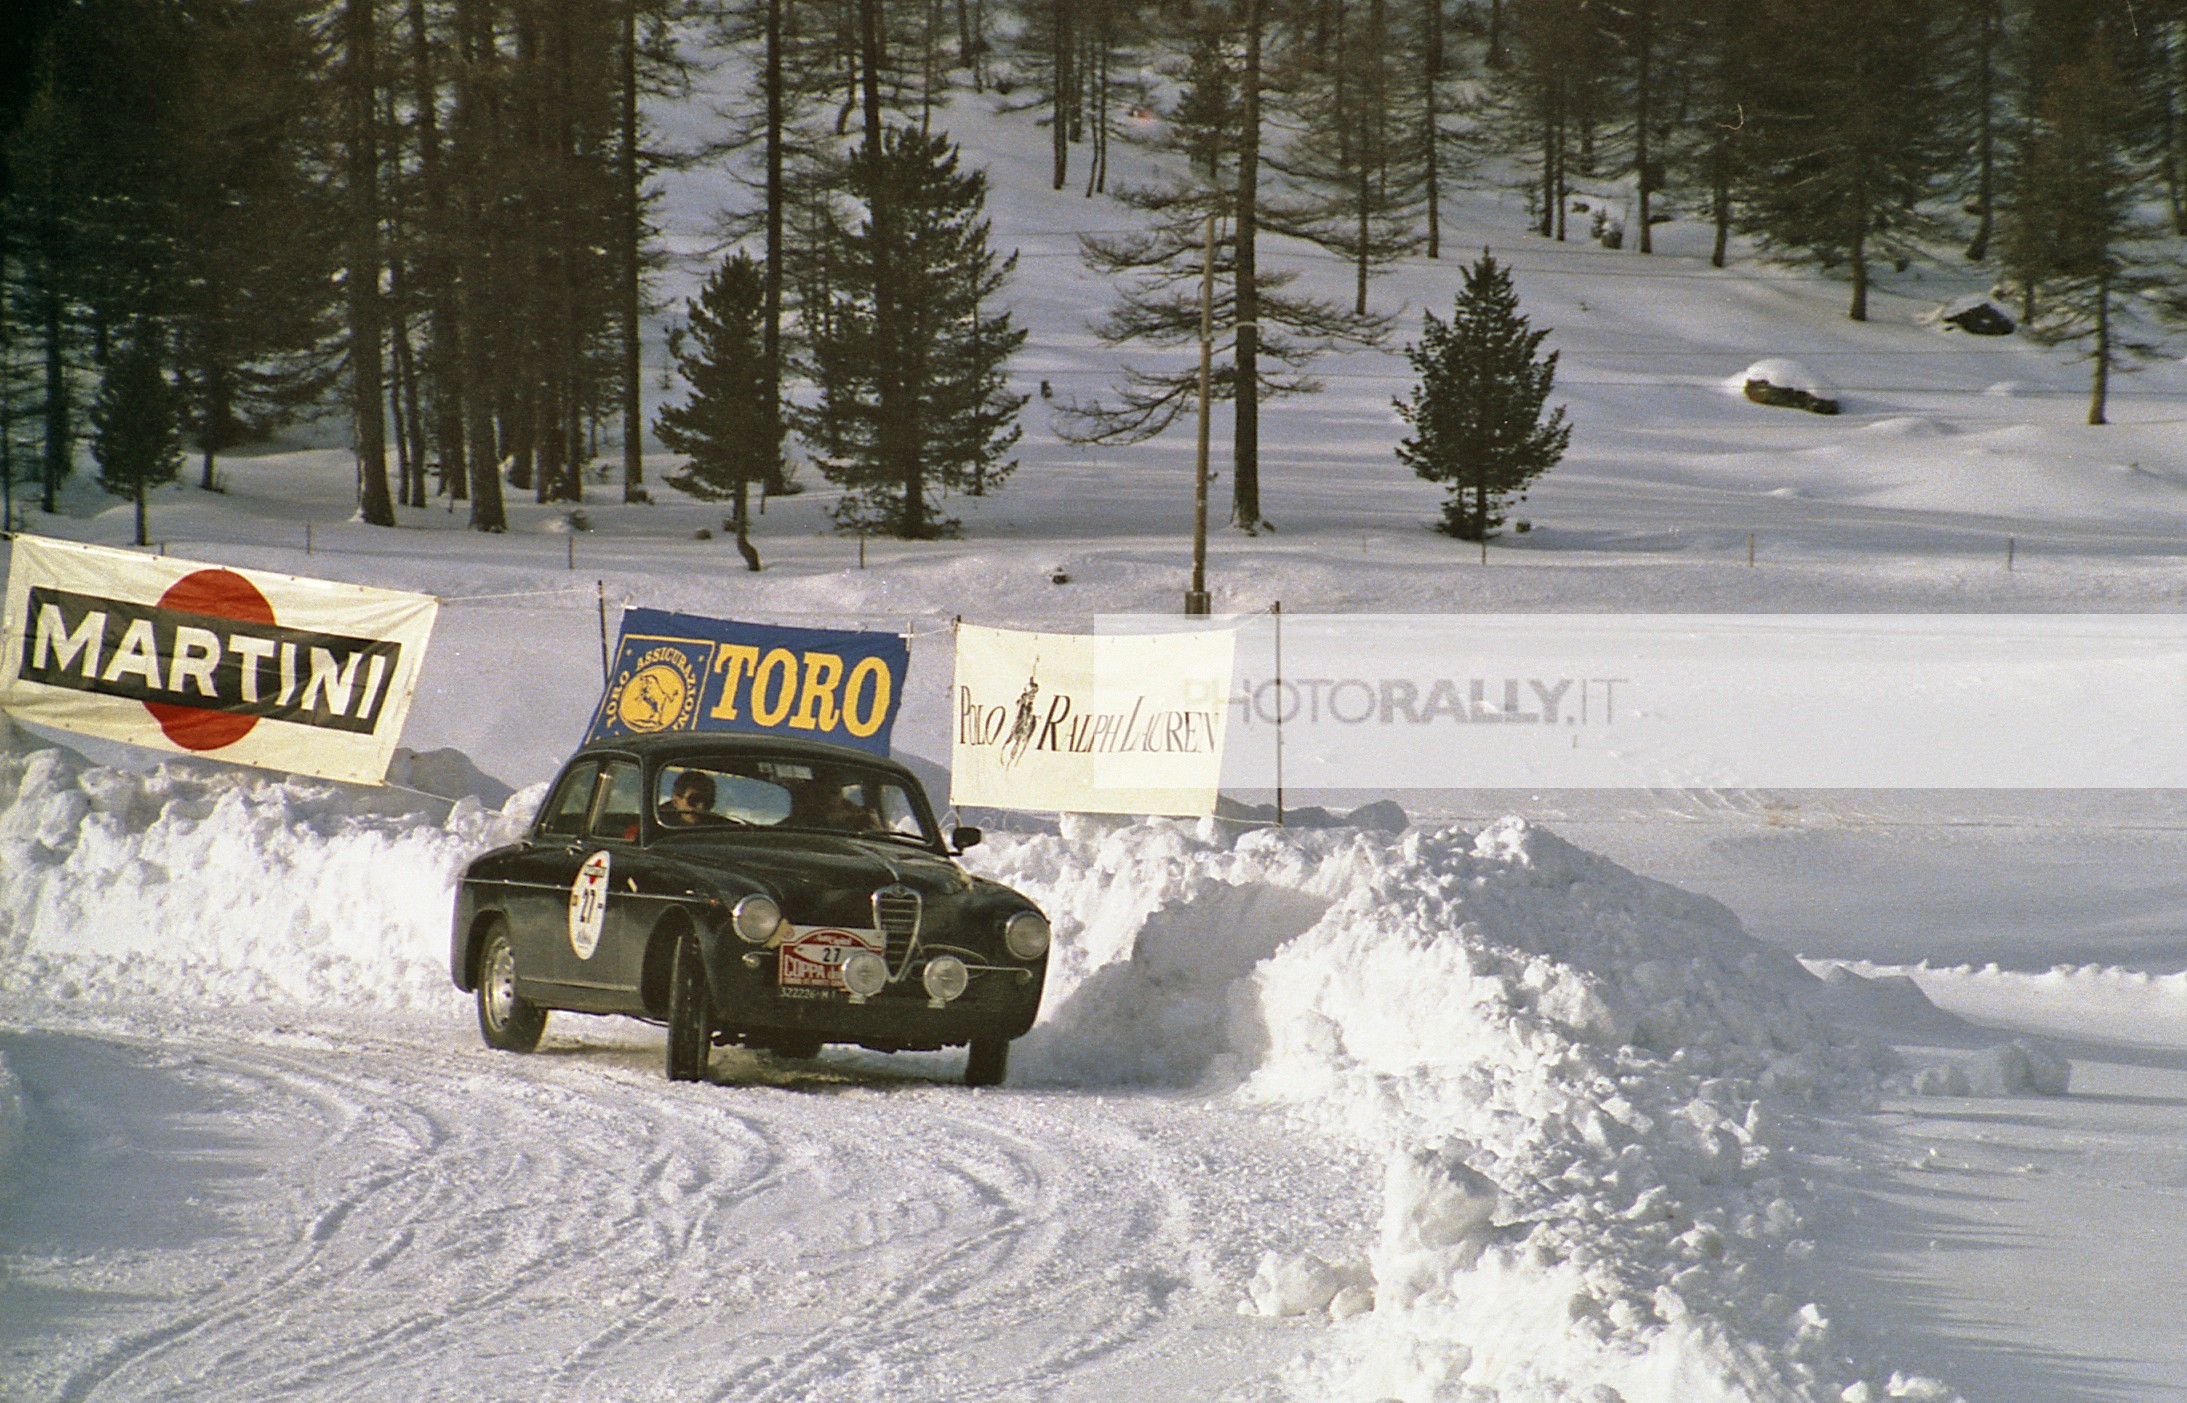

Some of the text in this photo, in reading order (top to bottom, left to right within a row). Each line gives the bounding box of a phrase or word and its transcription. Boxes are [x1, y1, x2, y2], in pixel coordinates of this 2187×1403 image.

[32, 602, 387, 720] MARTINI
[709, 643, 892, 738] TORO
[579, 888, 597, 925] 27
[822, 947, 841, 963] 27
